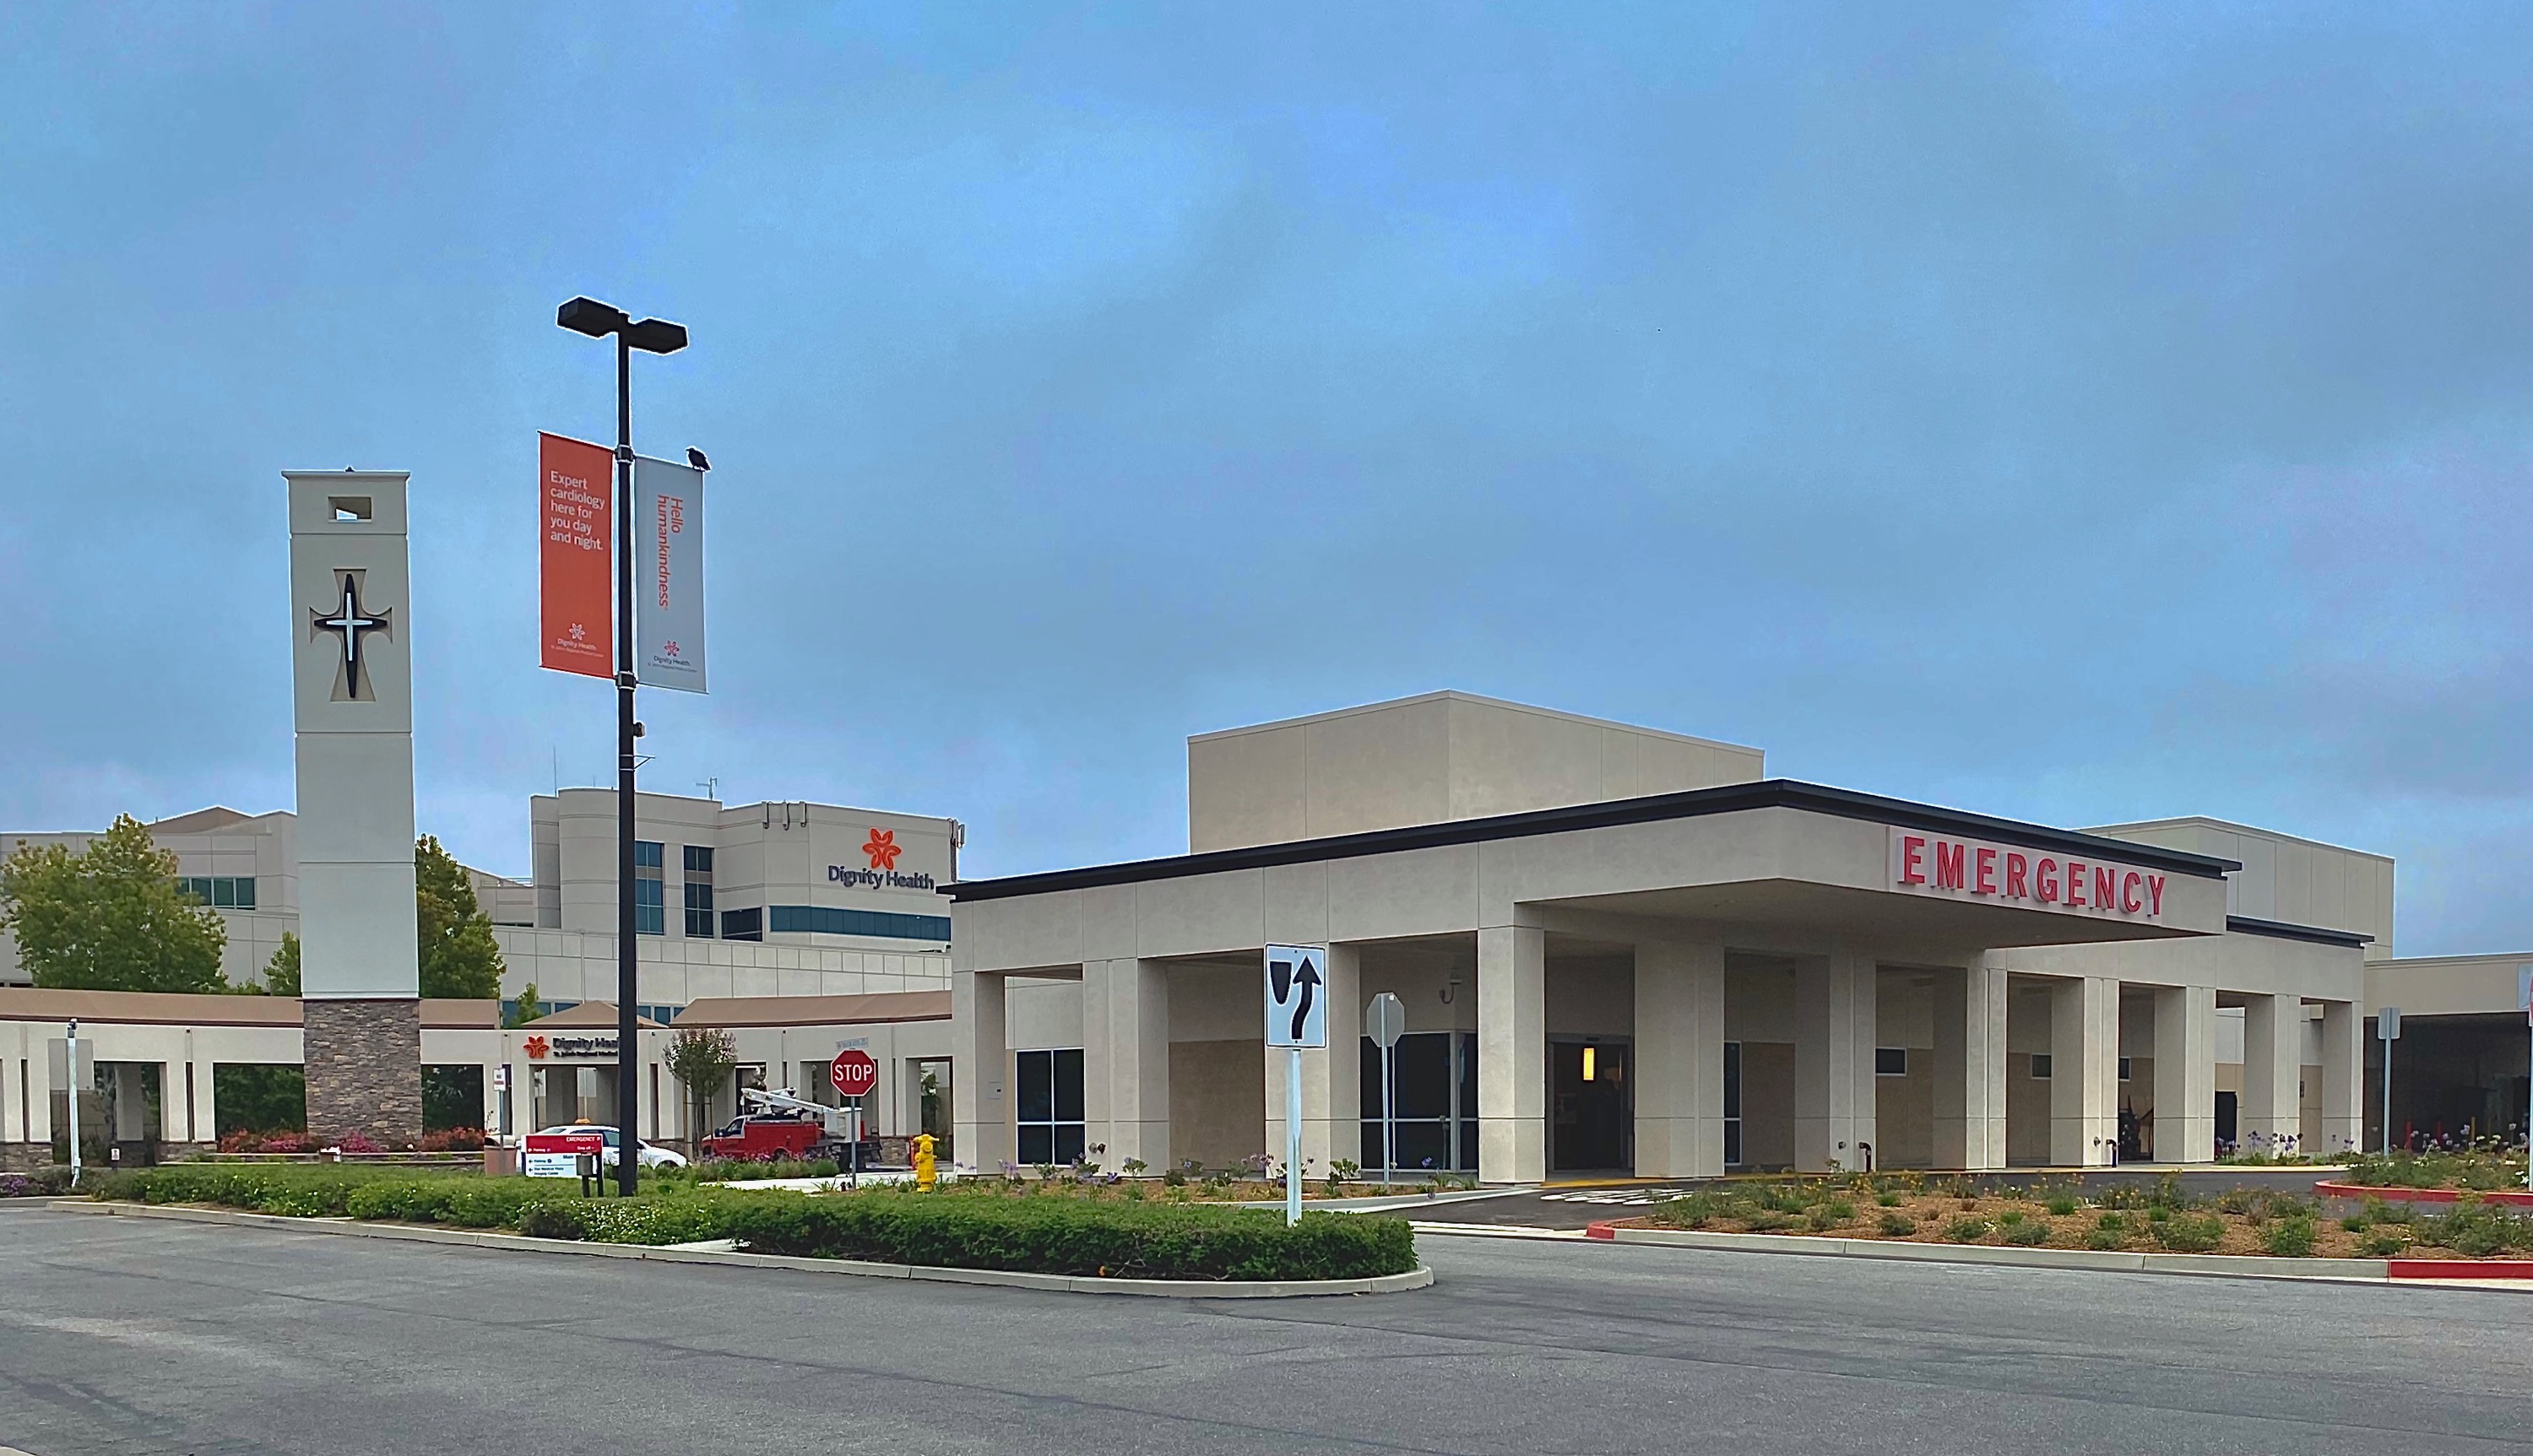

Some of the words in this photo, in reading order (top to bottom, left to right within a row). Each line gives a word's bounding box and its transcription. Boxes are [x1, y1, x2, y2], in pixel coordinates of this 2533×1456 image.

[551, 470, 588, 490] Expert
[550, 488, 605, 511] cardiology
[551, 499, 576, 516] here
[578, 505, 593, 519] for
[670, 497, 684, 533] Hello
[550, 516, 571, 529] you
[572, 519, 592, 536] day
[550, 531, 572, 544] and
[573, 534, 604, 550] night.
[827, 864, 884, 890] Dignity
[886, 870, 935, 890] Health
[1897, 835, 2166, 917] EMERGENCY
[552, 1037, 594, 1051] Dignity
[594, 1037, 620, 1048] Heal
[834, 1064, 873, 1081] STOP
